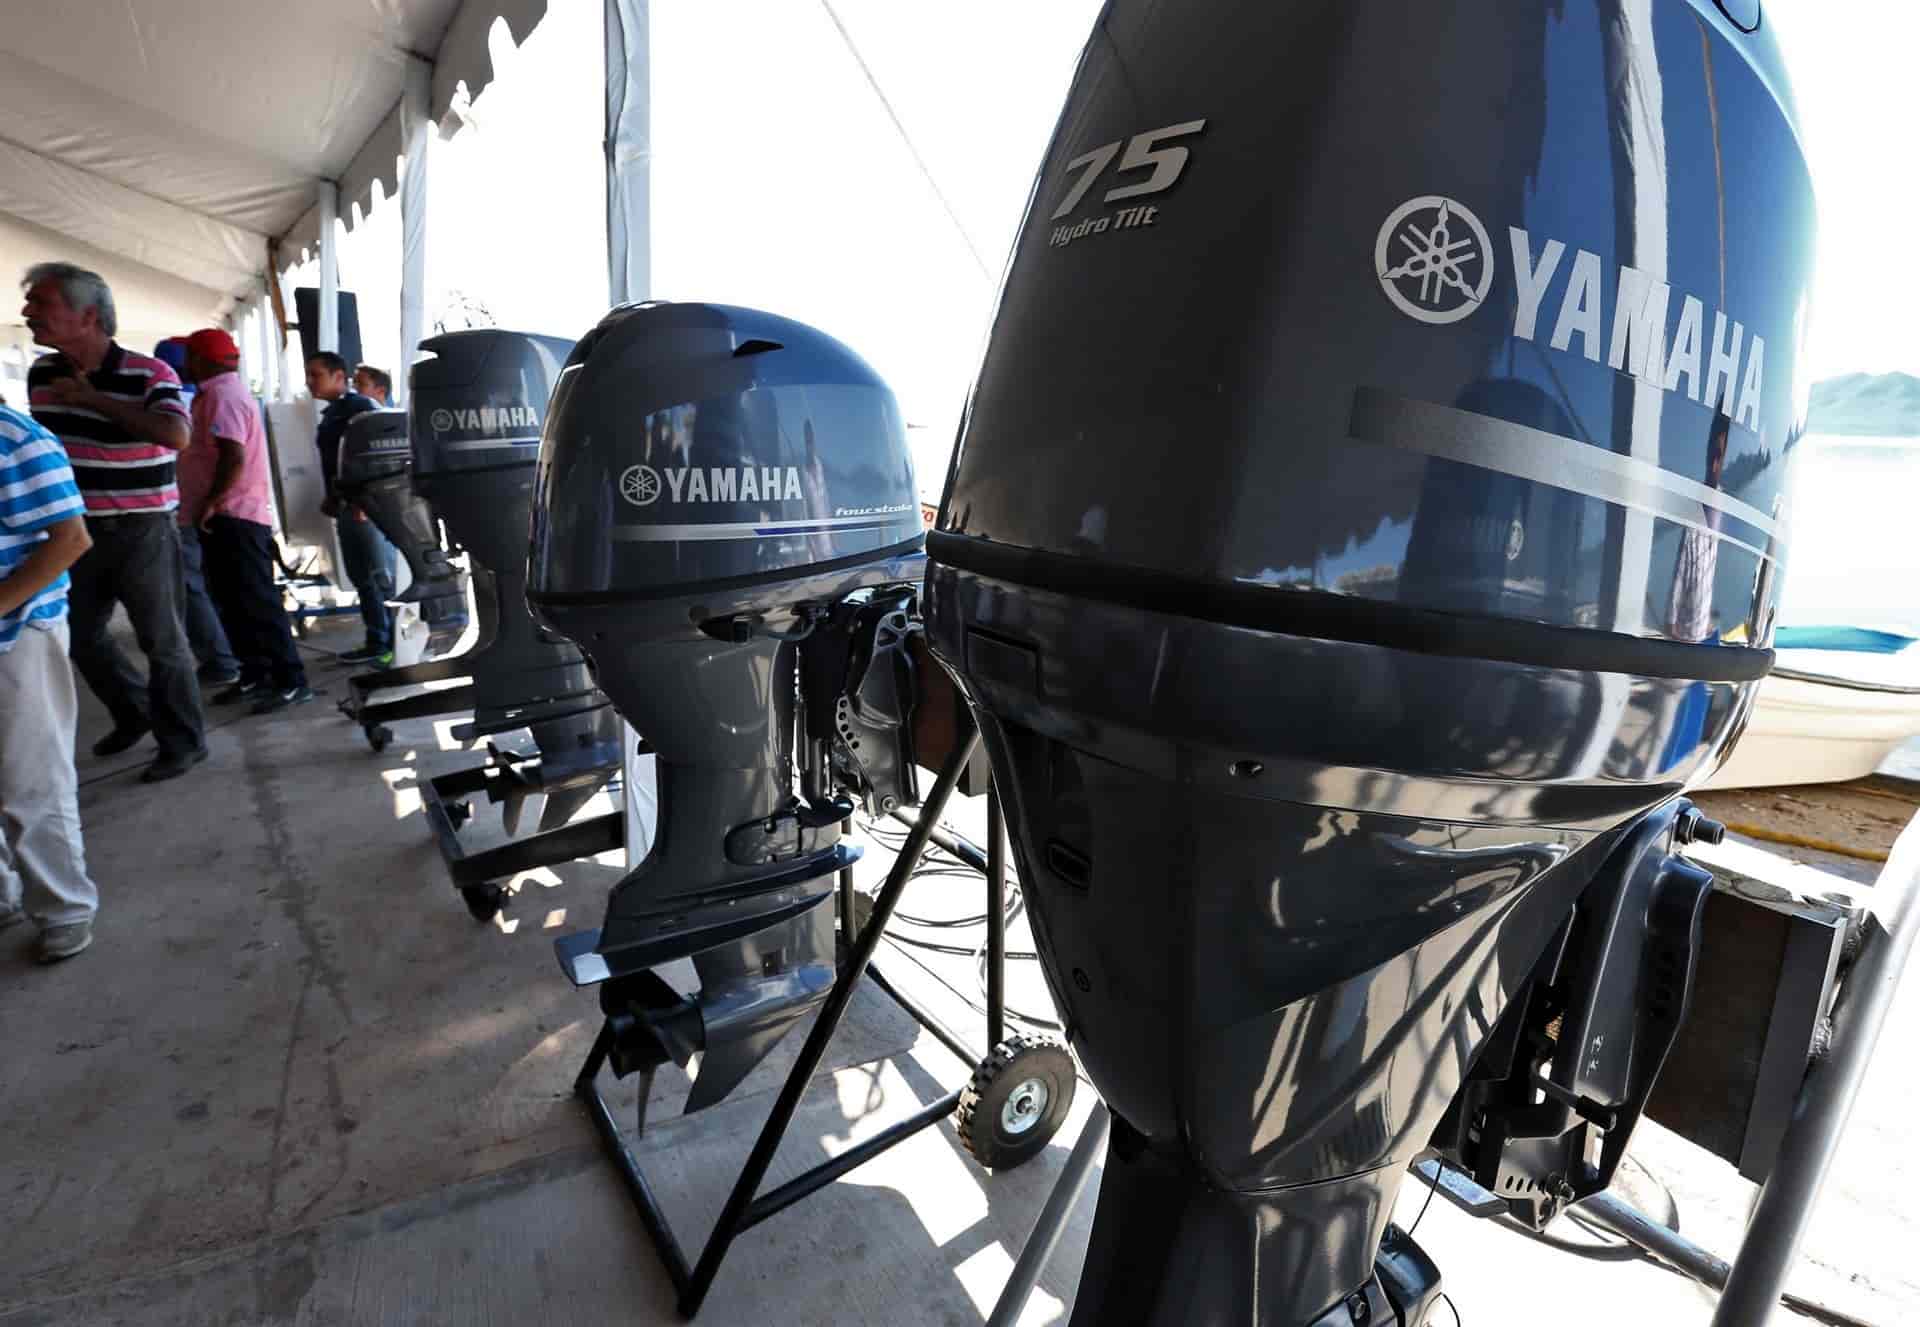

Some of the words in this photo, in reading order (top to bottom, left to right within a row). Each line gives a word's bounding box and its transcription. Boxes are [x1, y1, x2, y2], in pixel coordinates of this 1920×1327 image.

[1050, 119, 1207, 220] 75
[1050, 217, 1111, 247] Hydro
[1114, 205, 1158, 229] Tilt
[1508, 225, 1765, 433] YAMAHA
[453, 407, 539, 431] YAMAHA
[663, 466, 803, 503] YAMAHA
